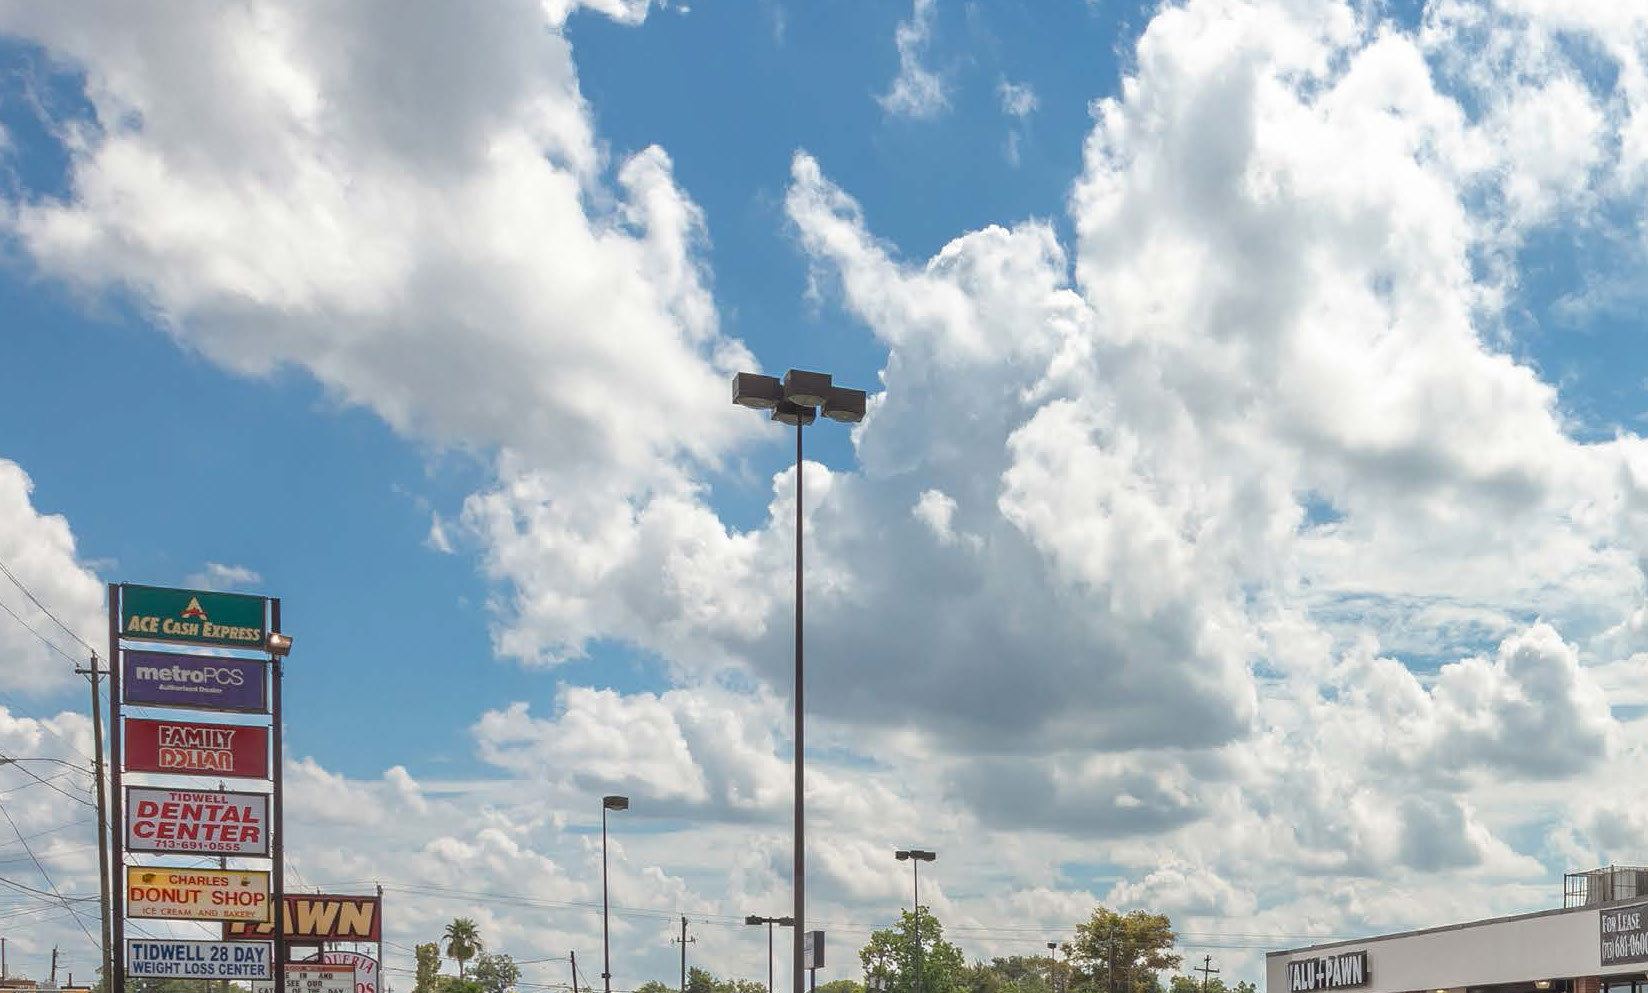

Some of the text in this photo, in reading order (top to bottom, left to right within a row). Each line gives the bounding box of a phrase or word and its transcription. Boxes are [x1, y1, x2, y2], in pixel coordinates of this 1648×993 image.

[128, 615, 261, 641] ACE CASH EXPRESS
[136, 665, 244, 685] metroPCS
[159, 725, 236, 749] FAMILY
[158, 748, 233, 771] DOLLAR
[169, 792, 228, 804] TIDWELL
[137, 800, 260, 824] DENTAL
[133, 820, 260, 843] CENTER
[154, 839, 240, 851] 713-691-0555
[168, 874, 229, 887] CHARLES
[130, 887, 265, 906] DONUT SHOP
[161, 908, 192, 916] CREAM
[231, 901, 375, 936] AWN
[1602, 914, 1617, 933] FOR
[1617, 912, 1641, 932] LEASE
[132, 944, 265, 963] TIDWELL 28 DAY
[133, 961, 265, 976] WEIGHT LOSS CENTER
